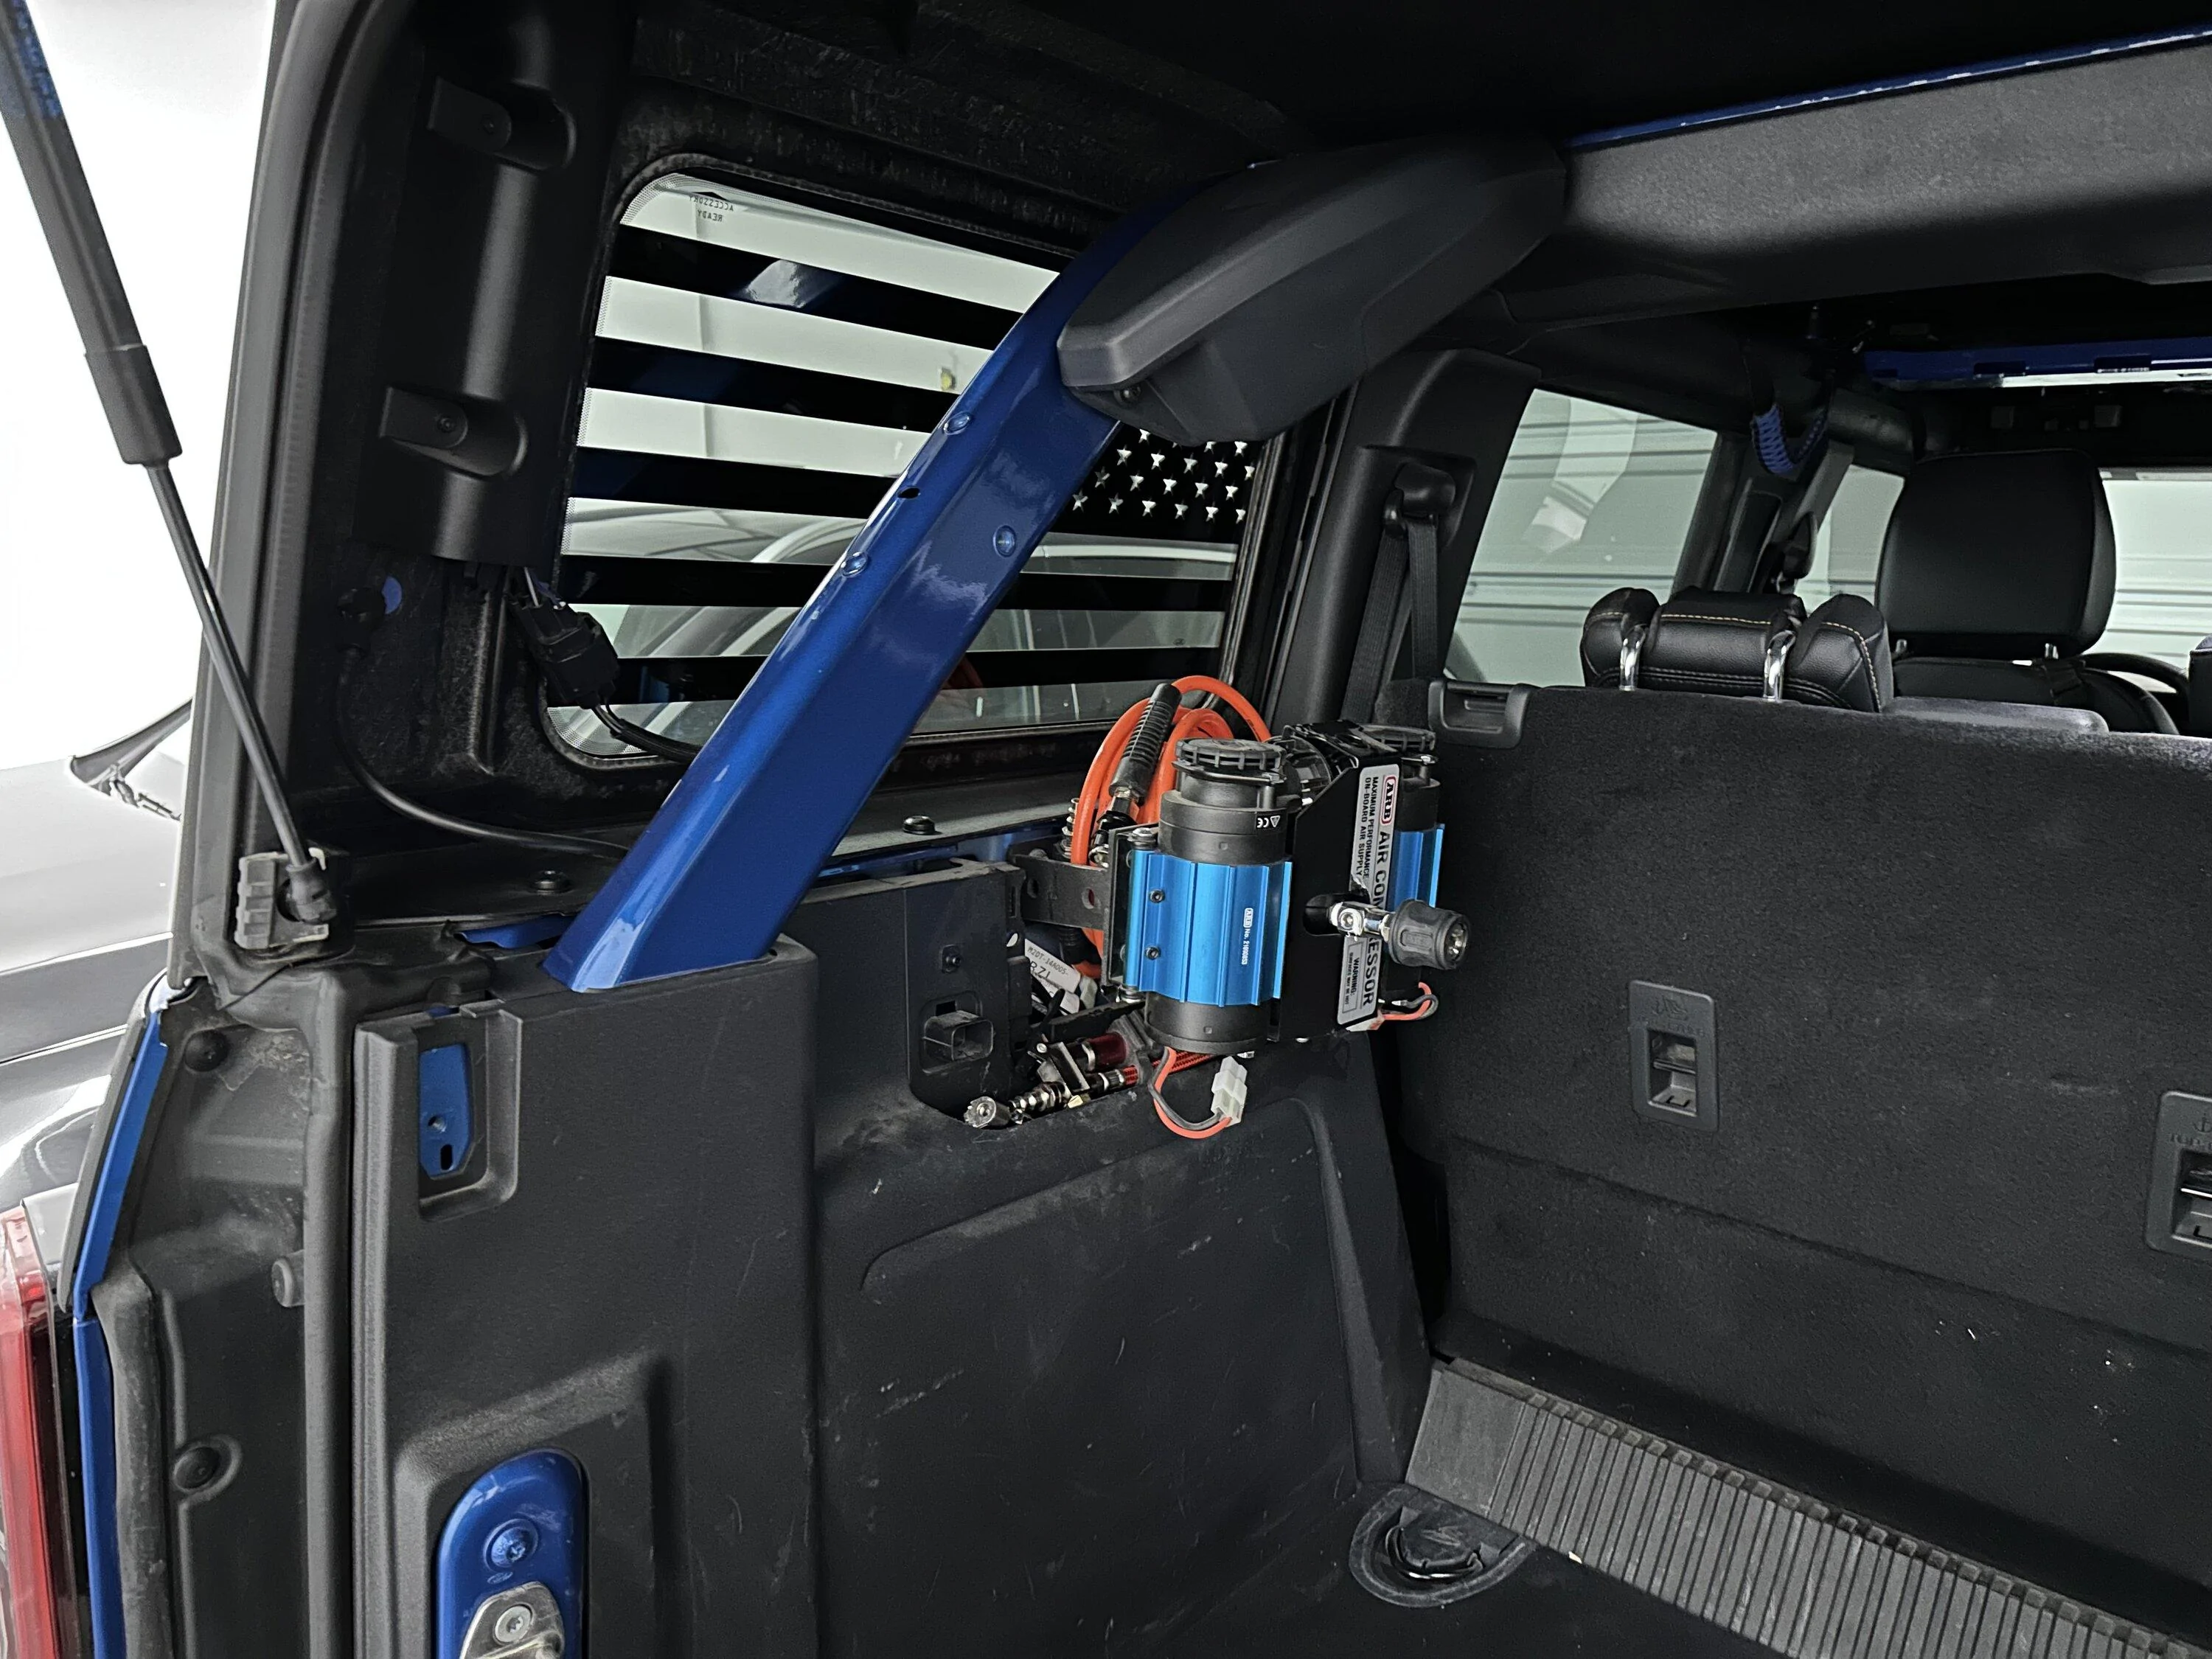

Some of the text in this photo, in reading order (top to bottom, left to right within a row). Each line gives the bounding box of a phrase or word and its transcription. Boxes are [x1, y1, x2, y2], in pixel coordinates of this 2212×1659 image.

[1383, 782, 1394, 820] ARB
[1356, 777, 1371, 877] ON-BOARD AIR SUPPLY
[1363, 776, 1379, 880] MAXIMUM PERFORMANCE
[1377, 831, 1391, 865] AIR
[1349, 957, 1360, 996] WARNING:
